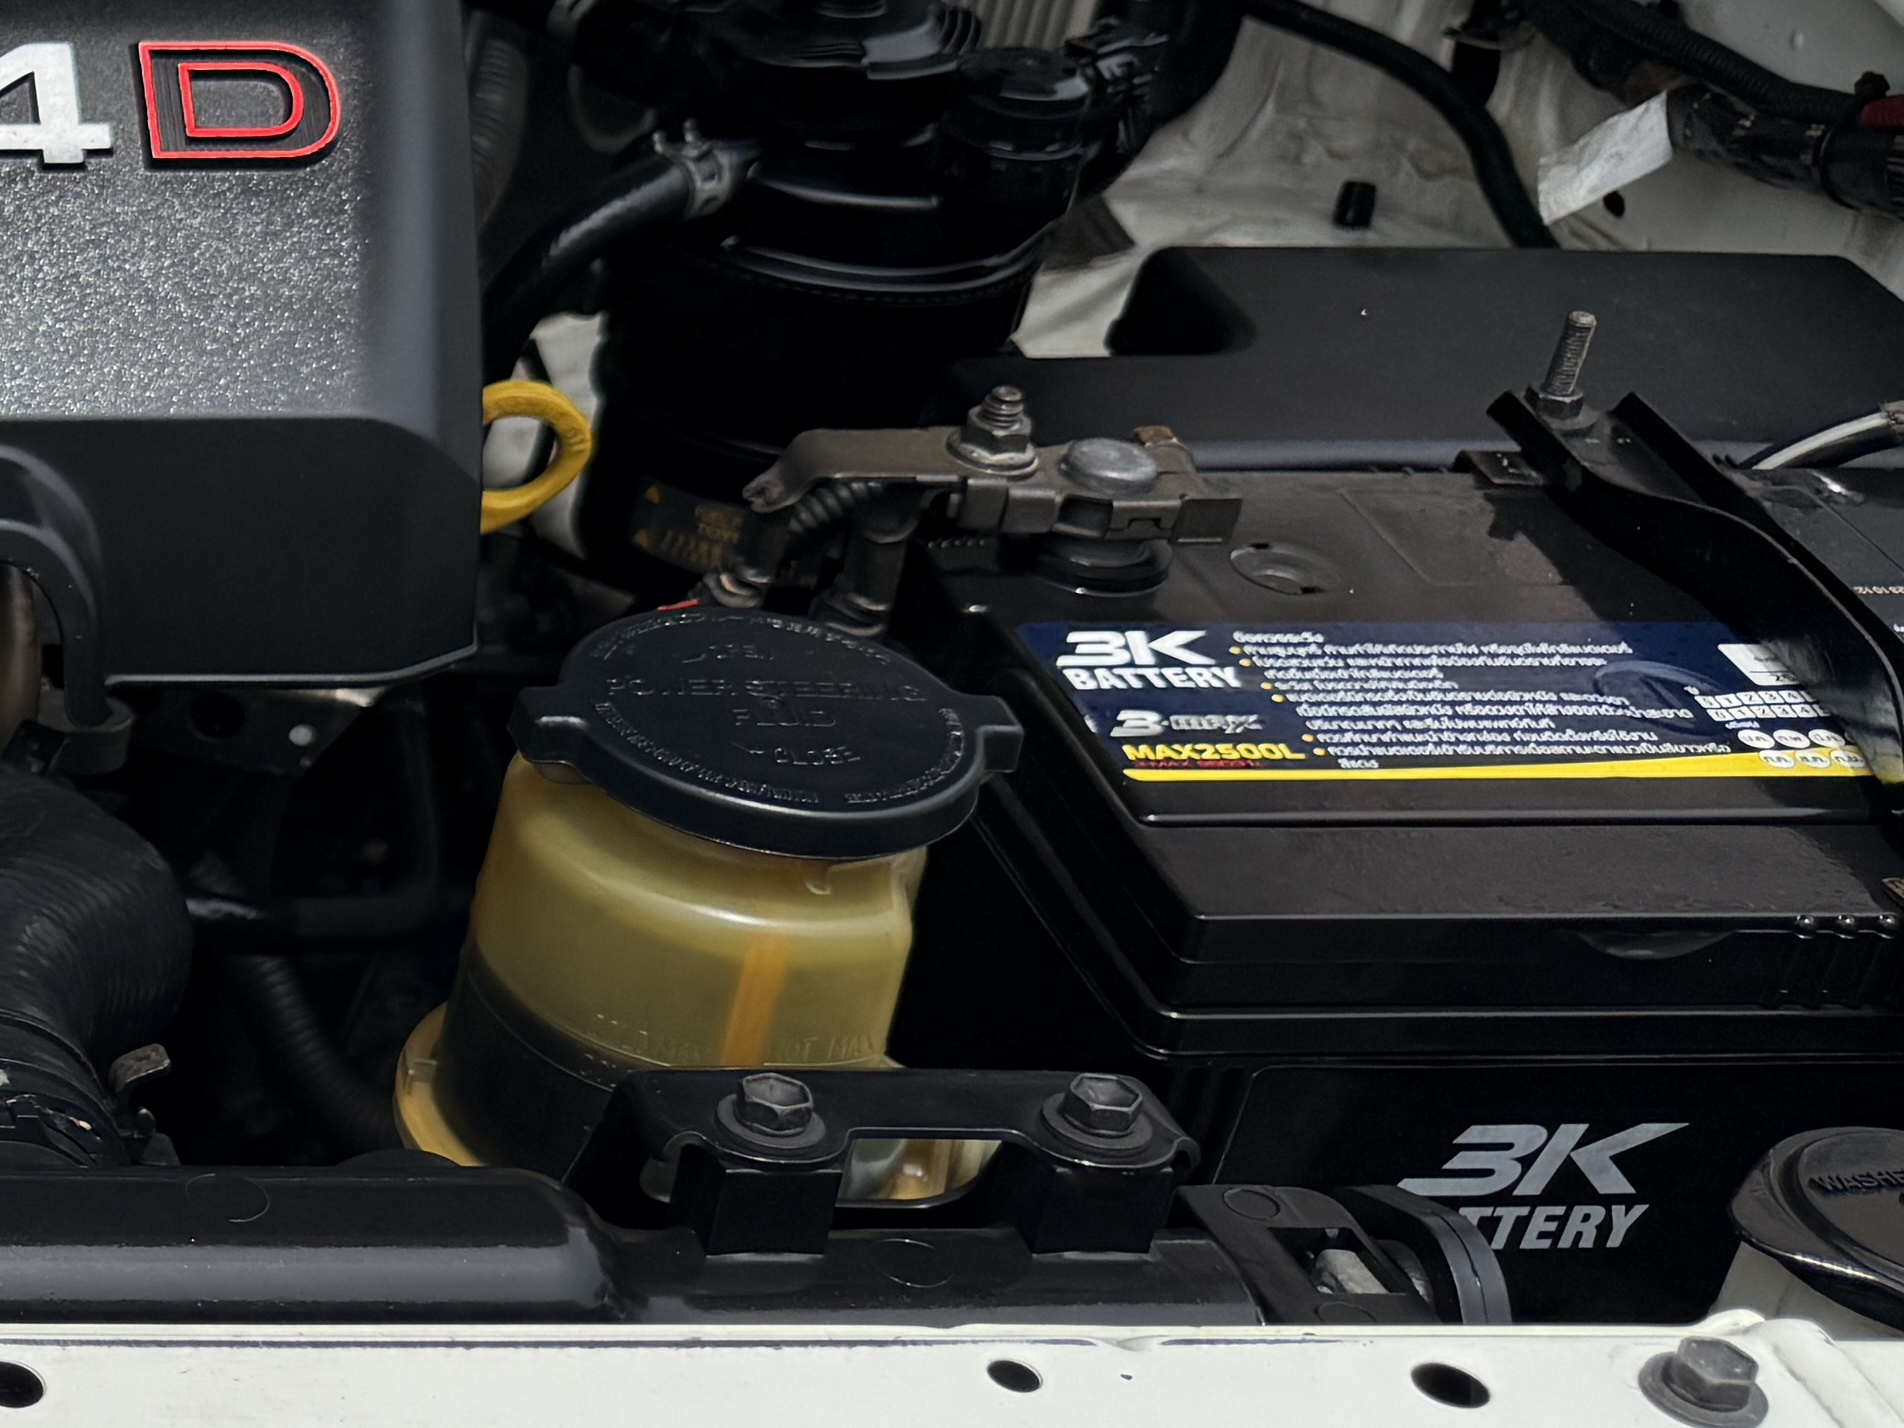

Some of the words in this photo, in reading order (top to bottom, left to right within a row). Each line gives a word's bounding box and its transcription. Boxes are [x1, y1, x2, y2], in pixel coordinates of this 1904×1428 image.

[1056, 630, 1216, 667] 3K
[606, 676, 738, 697] POWER
[743, 678, 929, 703] STEERING
[1062, 666, 1242, 691] BATTERY
[1122, 743, 1306, 761] MAX2500L
[1396, 1122, 1691, 1197] 3K
[1459, 1203, 1650, 1250] TTERY
